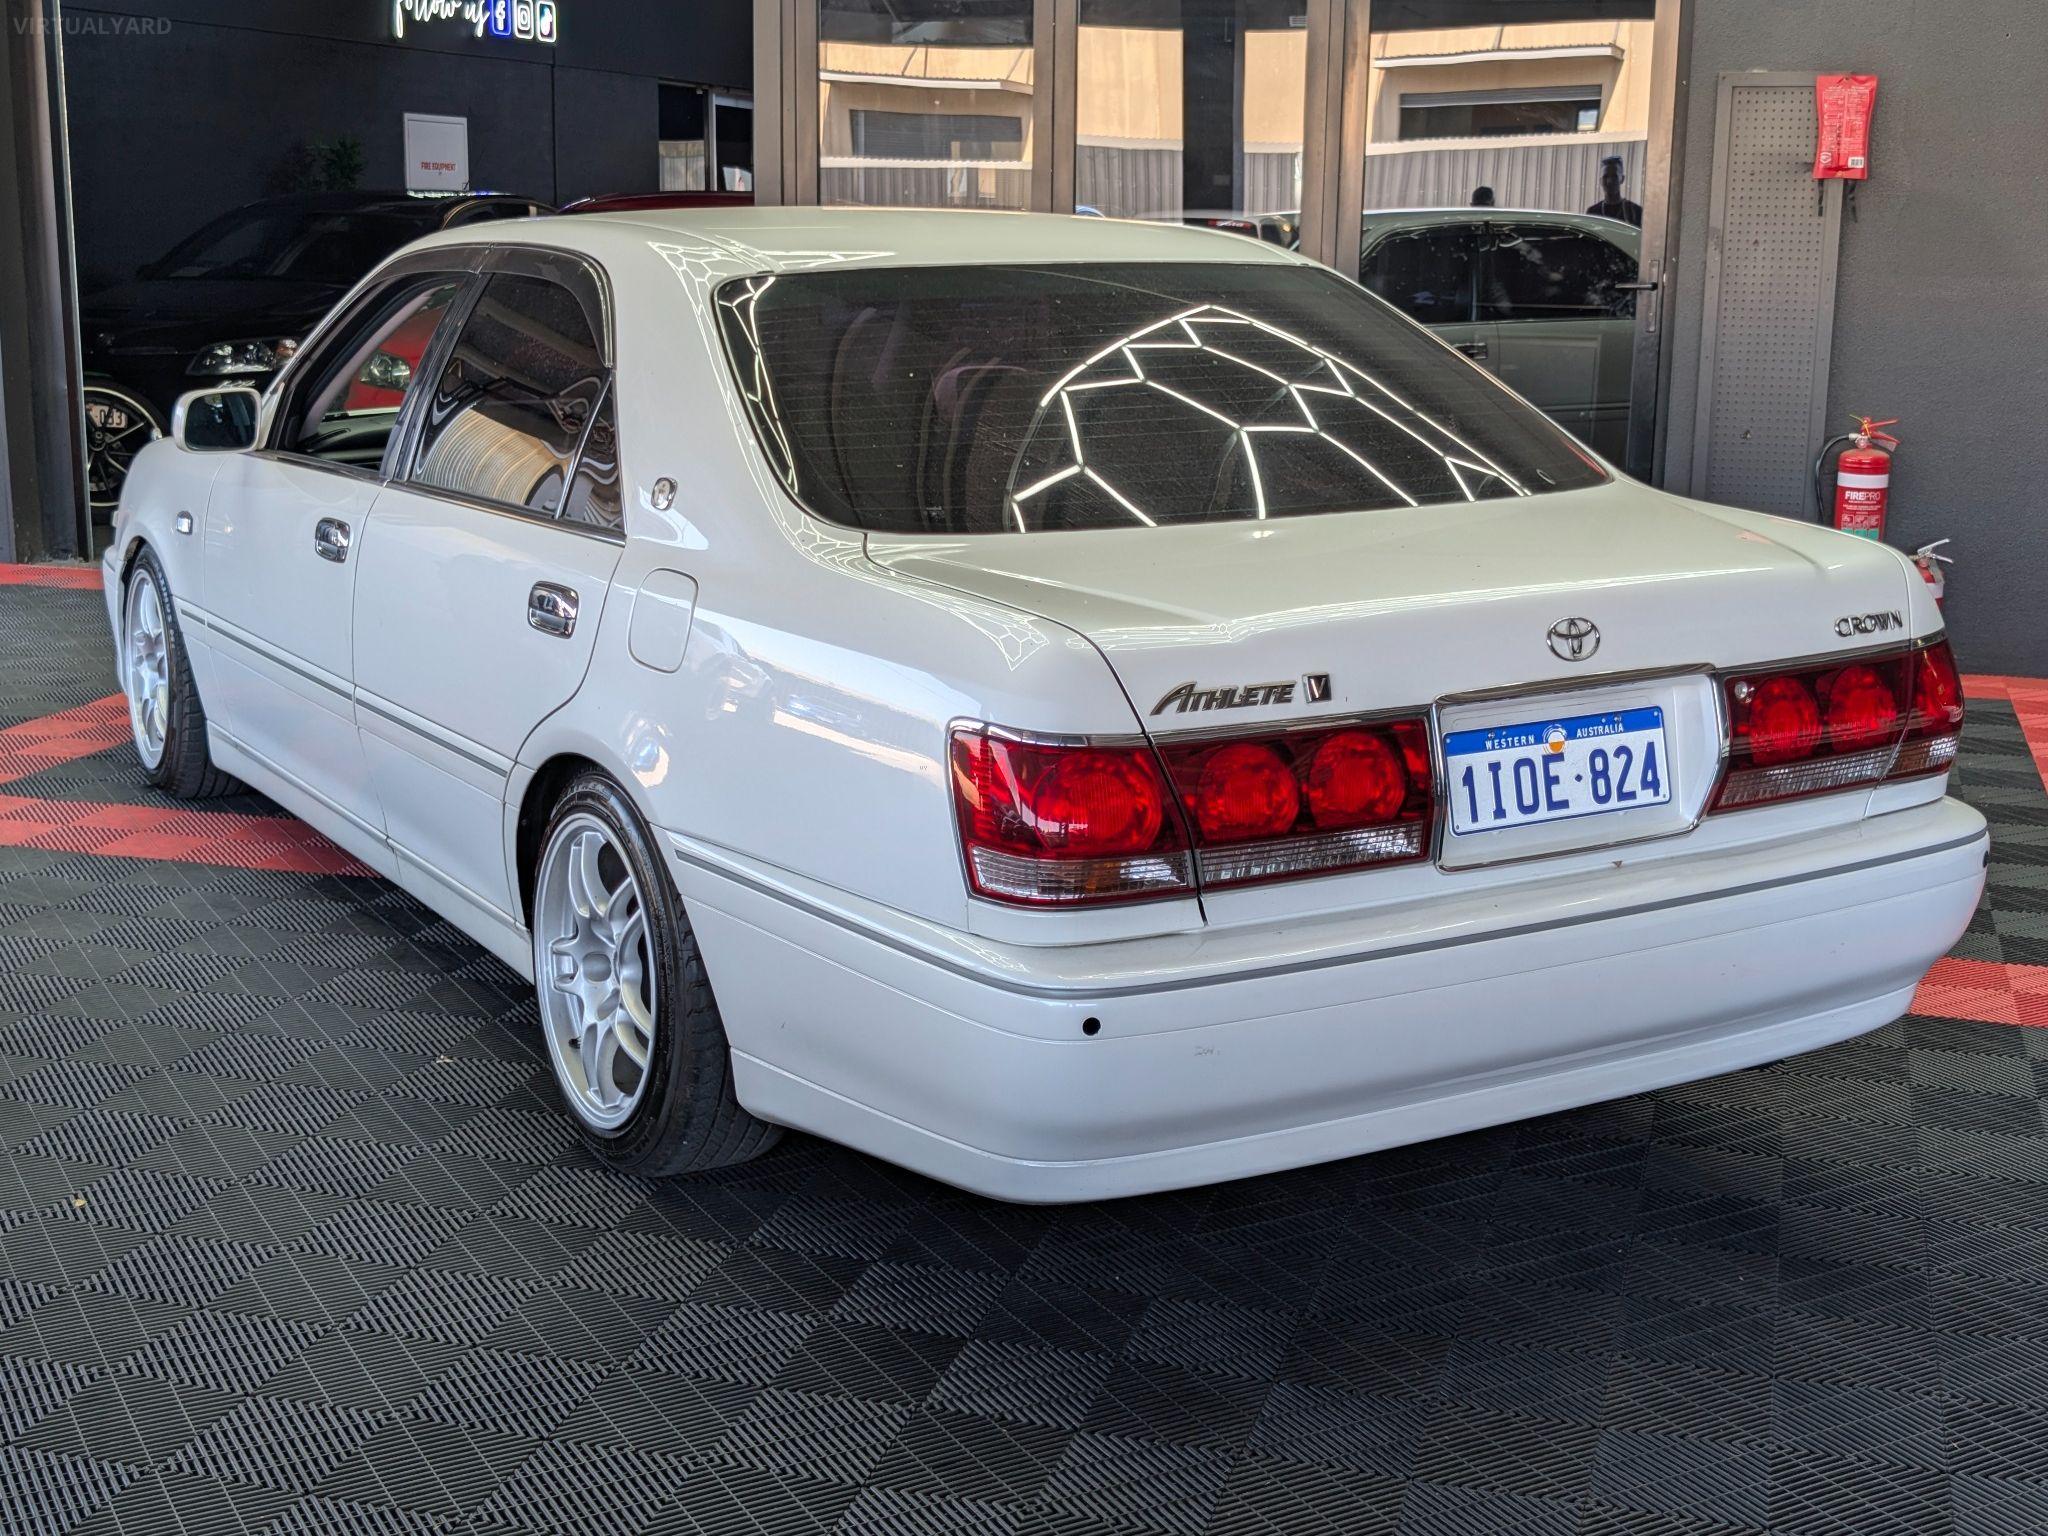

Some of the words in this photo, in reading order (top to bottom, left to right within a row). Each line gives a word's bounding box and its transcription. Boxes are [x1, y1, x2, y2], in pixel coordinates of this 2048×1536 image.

[420, 161, 431, 170] FIRE
[432, 161, 456, 172] EQUIPMENT
[1834, 611, 1904, 637] CROWN
[1150, 680, 1298, 717] ATHLETE
[1485, 734, 1535, 750] WESTERN
[1576, 723, 1624, 738] AUSTRALIA
